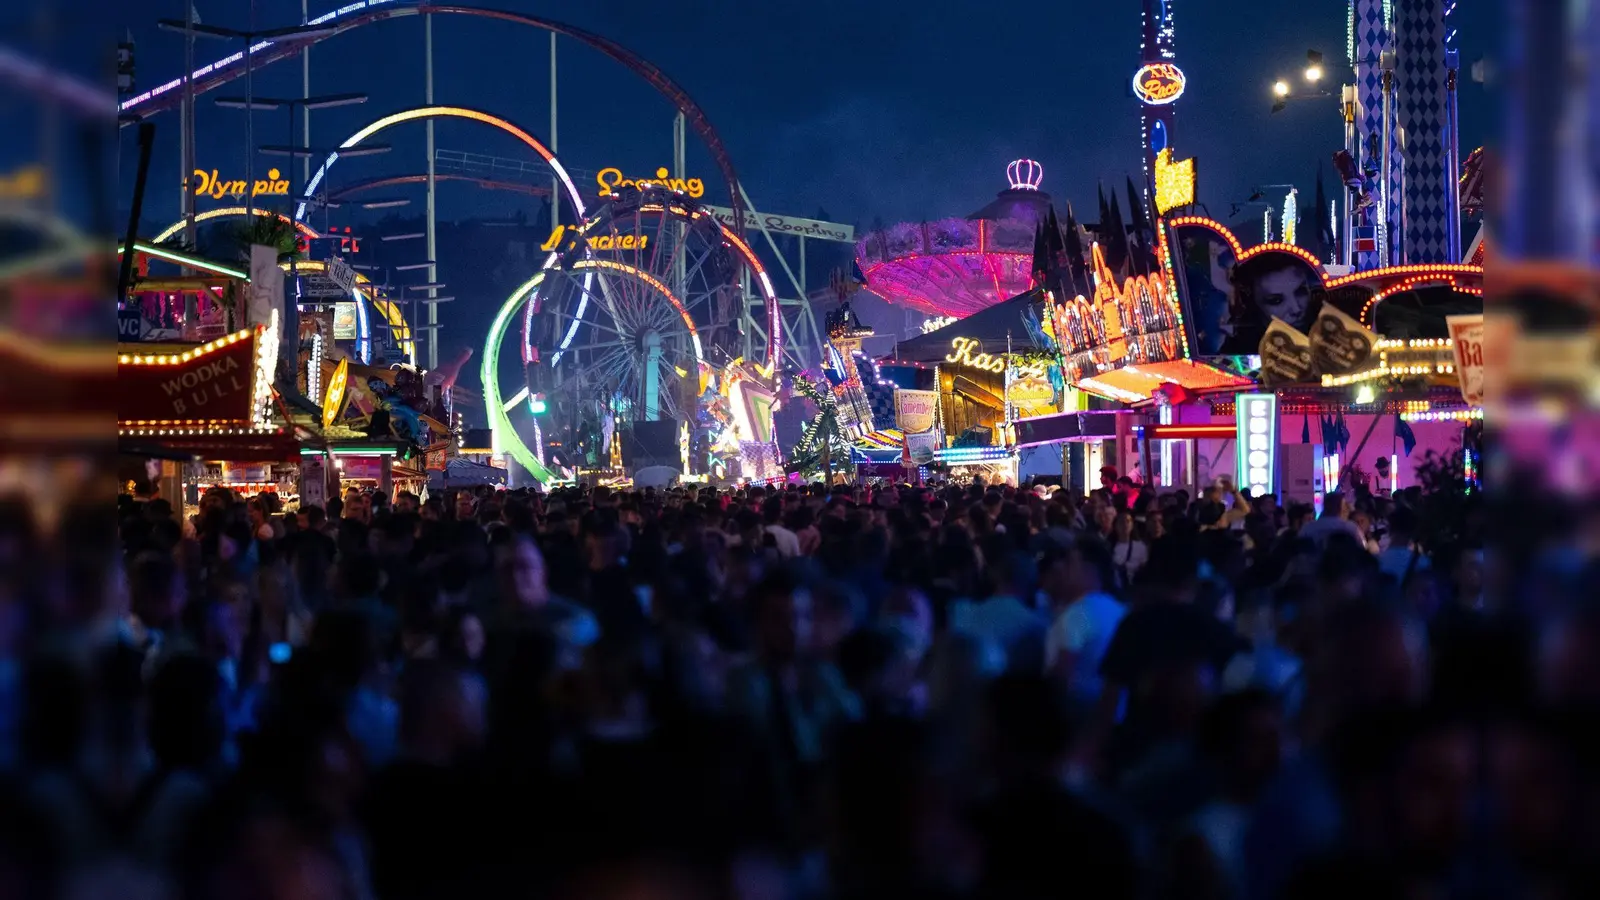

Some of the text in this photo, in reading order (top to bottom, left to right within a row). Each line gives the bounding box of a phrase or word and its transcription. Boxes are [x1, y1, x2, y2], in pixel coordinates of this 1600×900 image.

[184, 168, 290, 200] Olympia
[765, 217, 848, 241] Looping
[161, 355, 240, 396] WODKA
[173, 375, 245, 415] BULL
